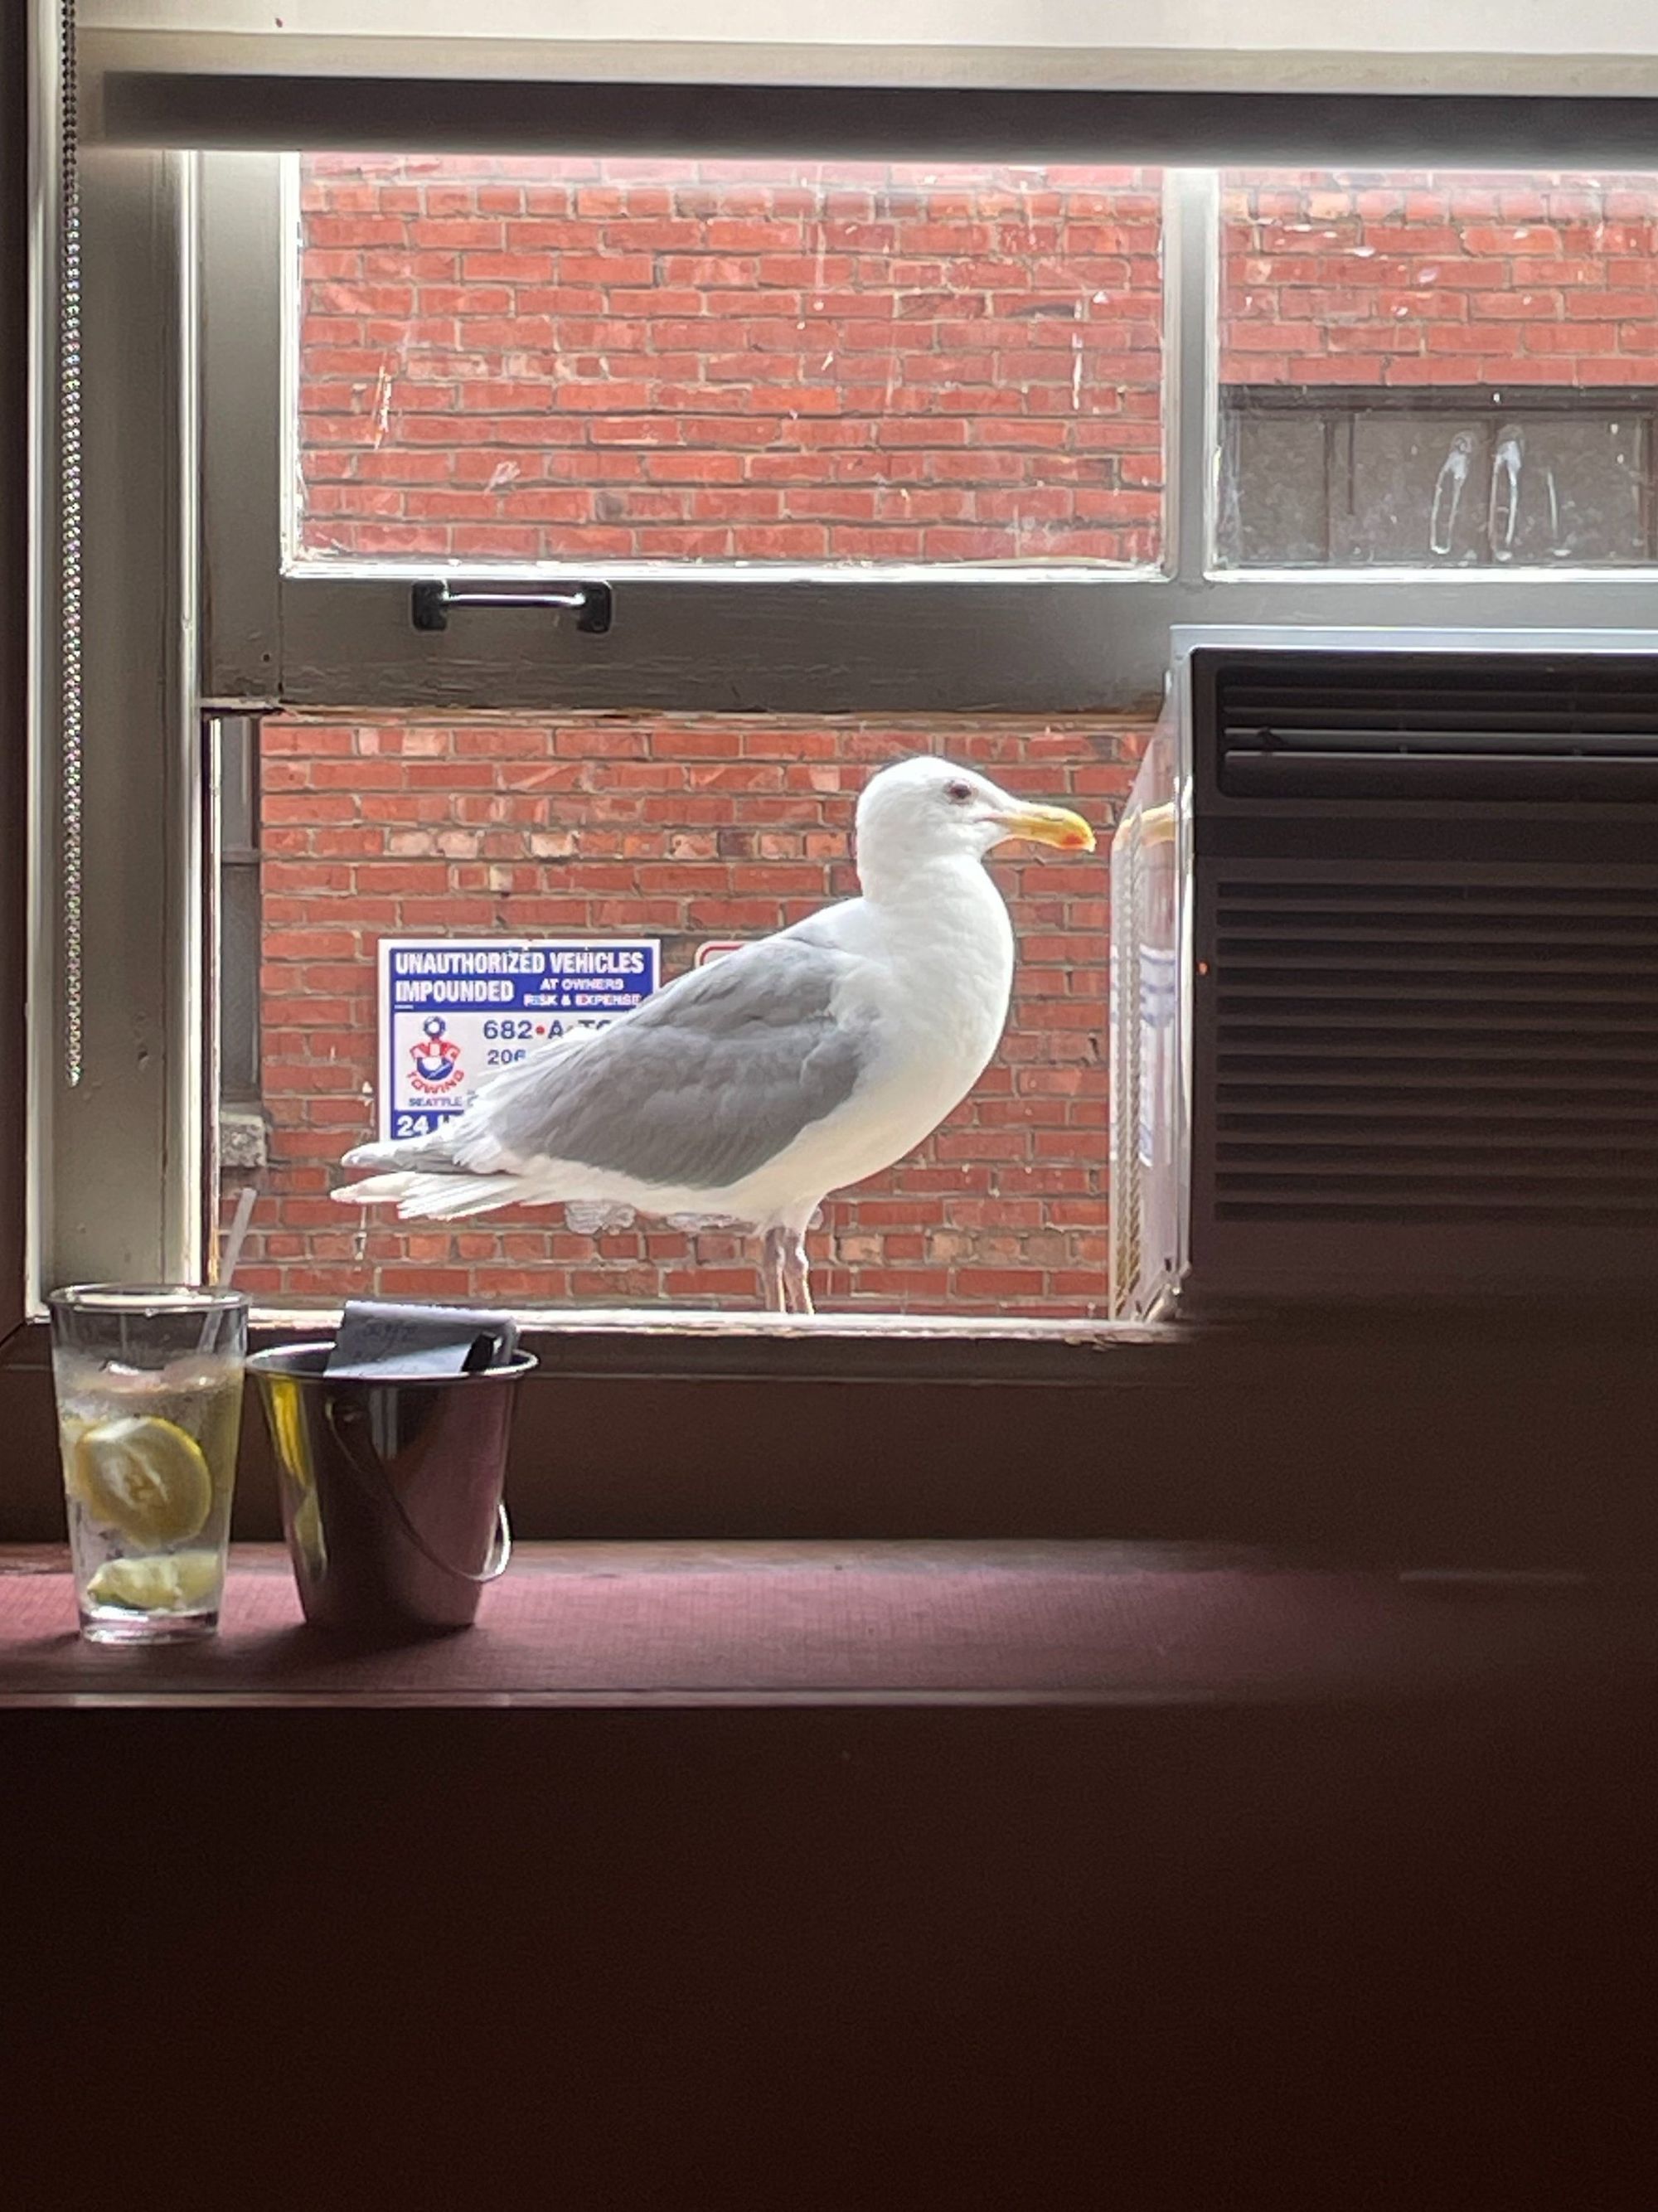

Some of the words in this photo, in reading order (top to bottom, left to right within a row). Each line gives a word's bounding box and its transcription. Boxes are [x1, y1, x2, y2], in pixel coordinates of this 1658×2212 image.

[395, 952, 545, 974] UNAUTHORIZED
[550, 952, 644, 974] VEHICLES
[395, 980, 514, 1002] IMPOUNDED
[540, 978, 559, 990] AT
[562, 978, 624, 991] OWNERS
[523, 994, 558, 1007] RISK
[560, 994, 571, 1006] &
[574, 994, 641, 1007] EXPENSE
[406, 1069, 465, 1094] TOWING
[409, 1097, 463, 1107] SEATTLE
[396, 1114, 429, 1137] 24
